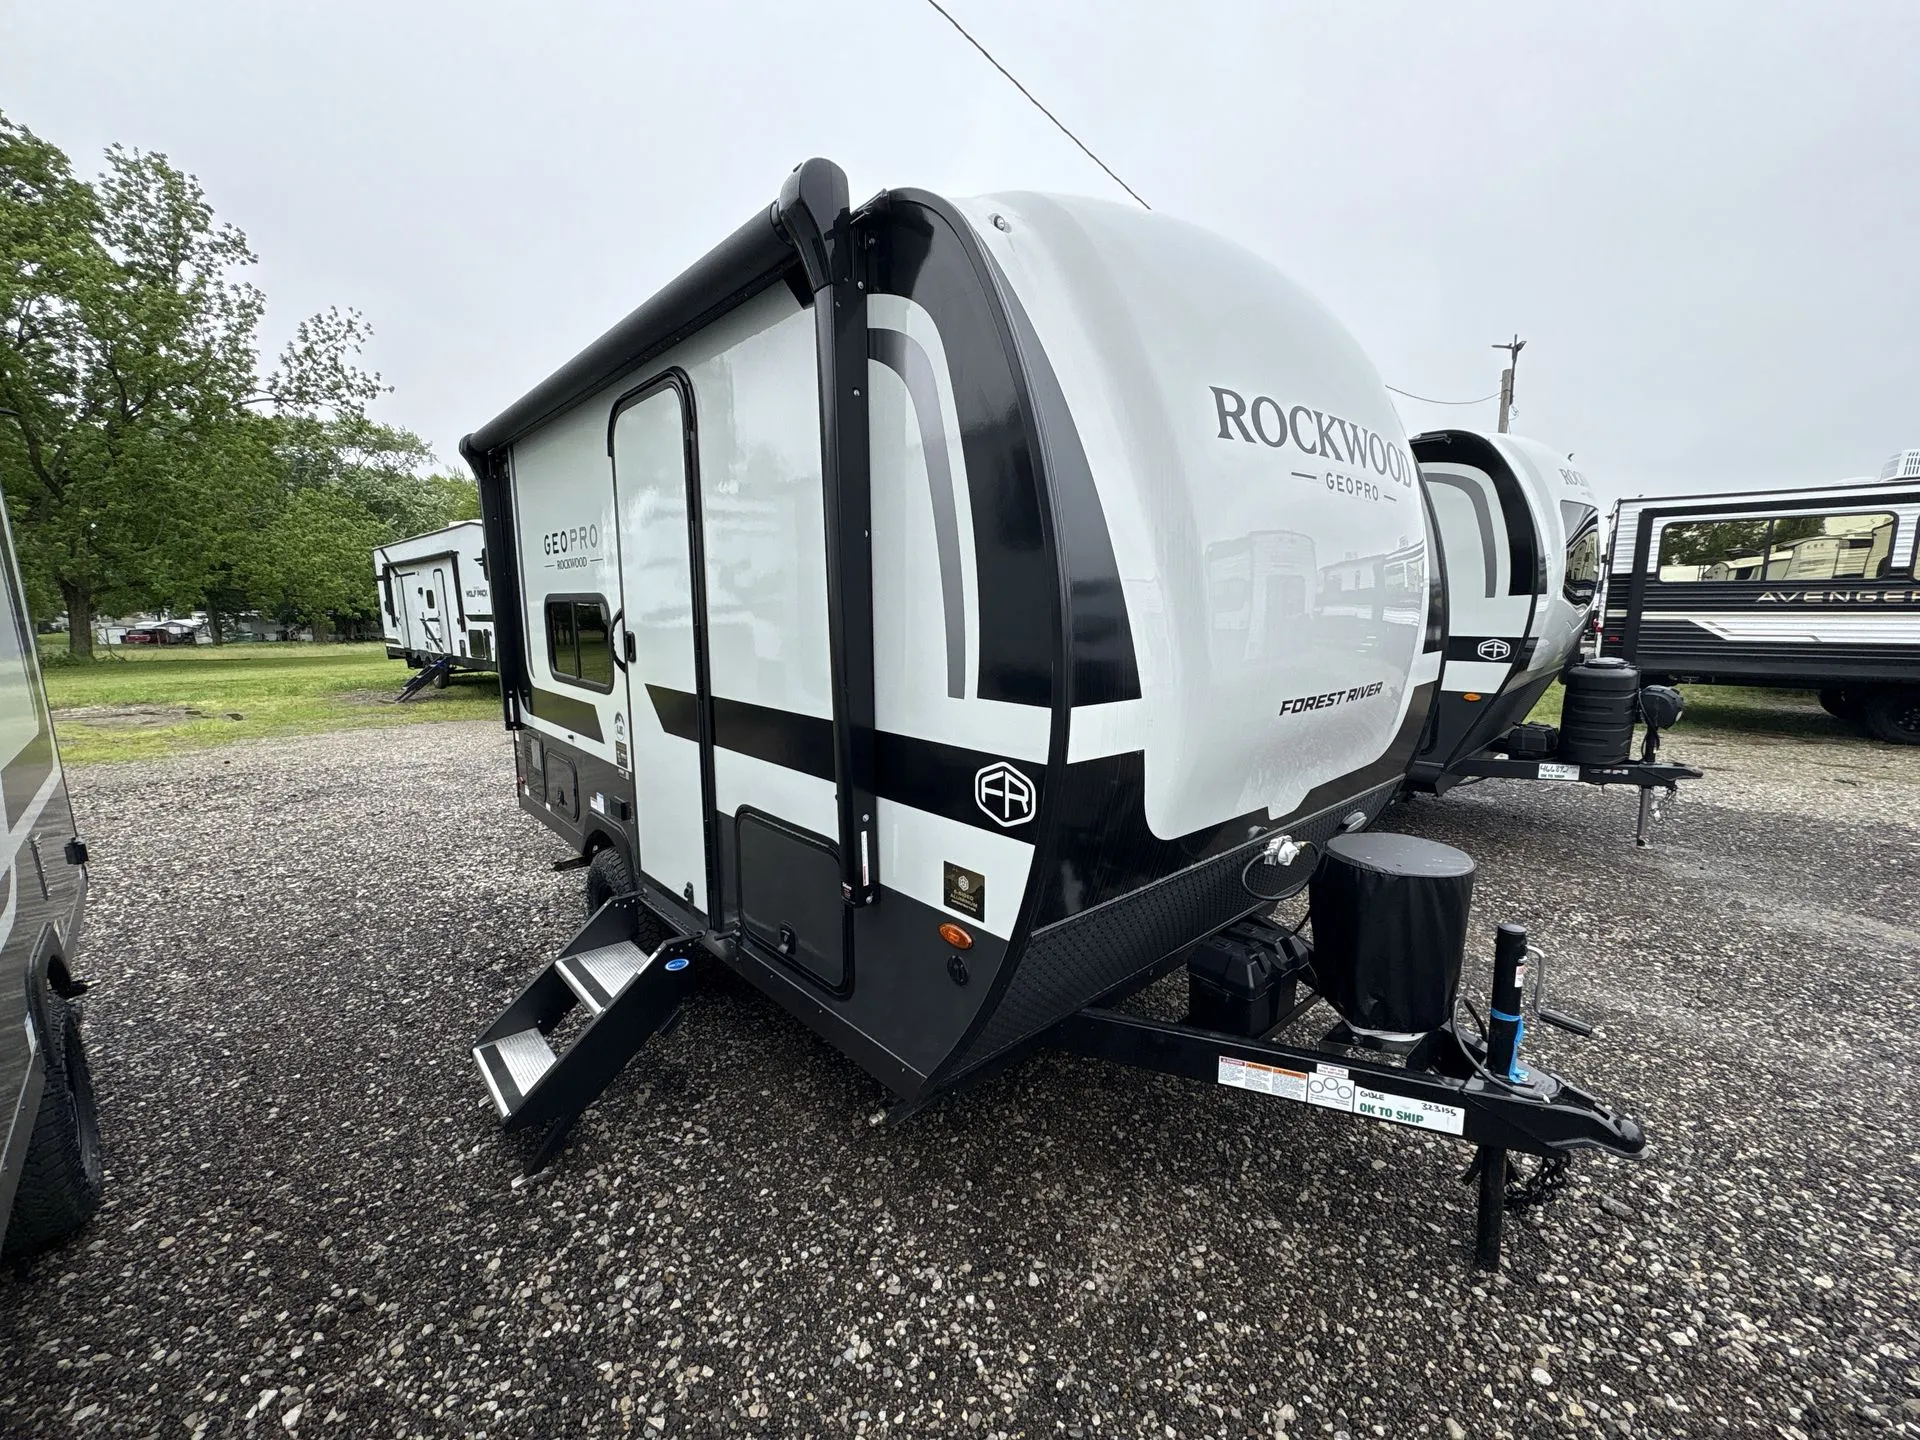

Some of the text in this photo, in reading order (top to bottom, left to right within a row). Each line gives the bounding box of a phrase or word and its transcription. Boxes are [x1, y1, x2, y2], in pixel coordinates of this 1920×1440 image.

[1209, 385, 1412, 489] ROCKWOOD
[1325, 472, 1379, 502] GEOPRO
[543, 523, 598, 556] GEOPRO
[556, 556, 588, 570] ROCKWOOD
[1279, 681, 1384, 716] FOREST RIVER
[1359, 1102, 1424, 1124] OK TO SHIP
